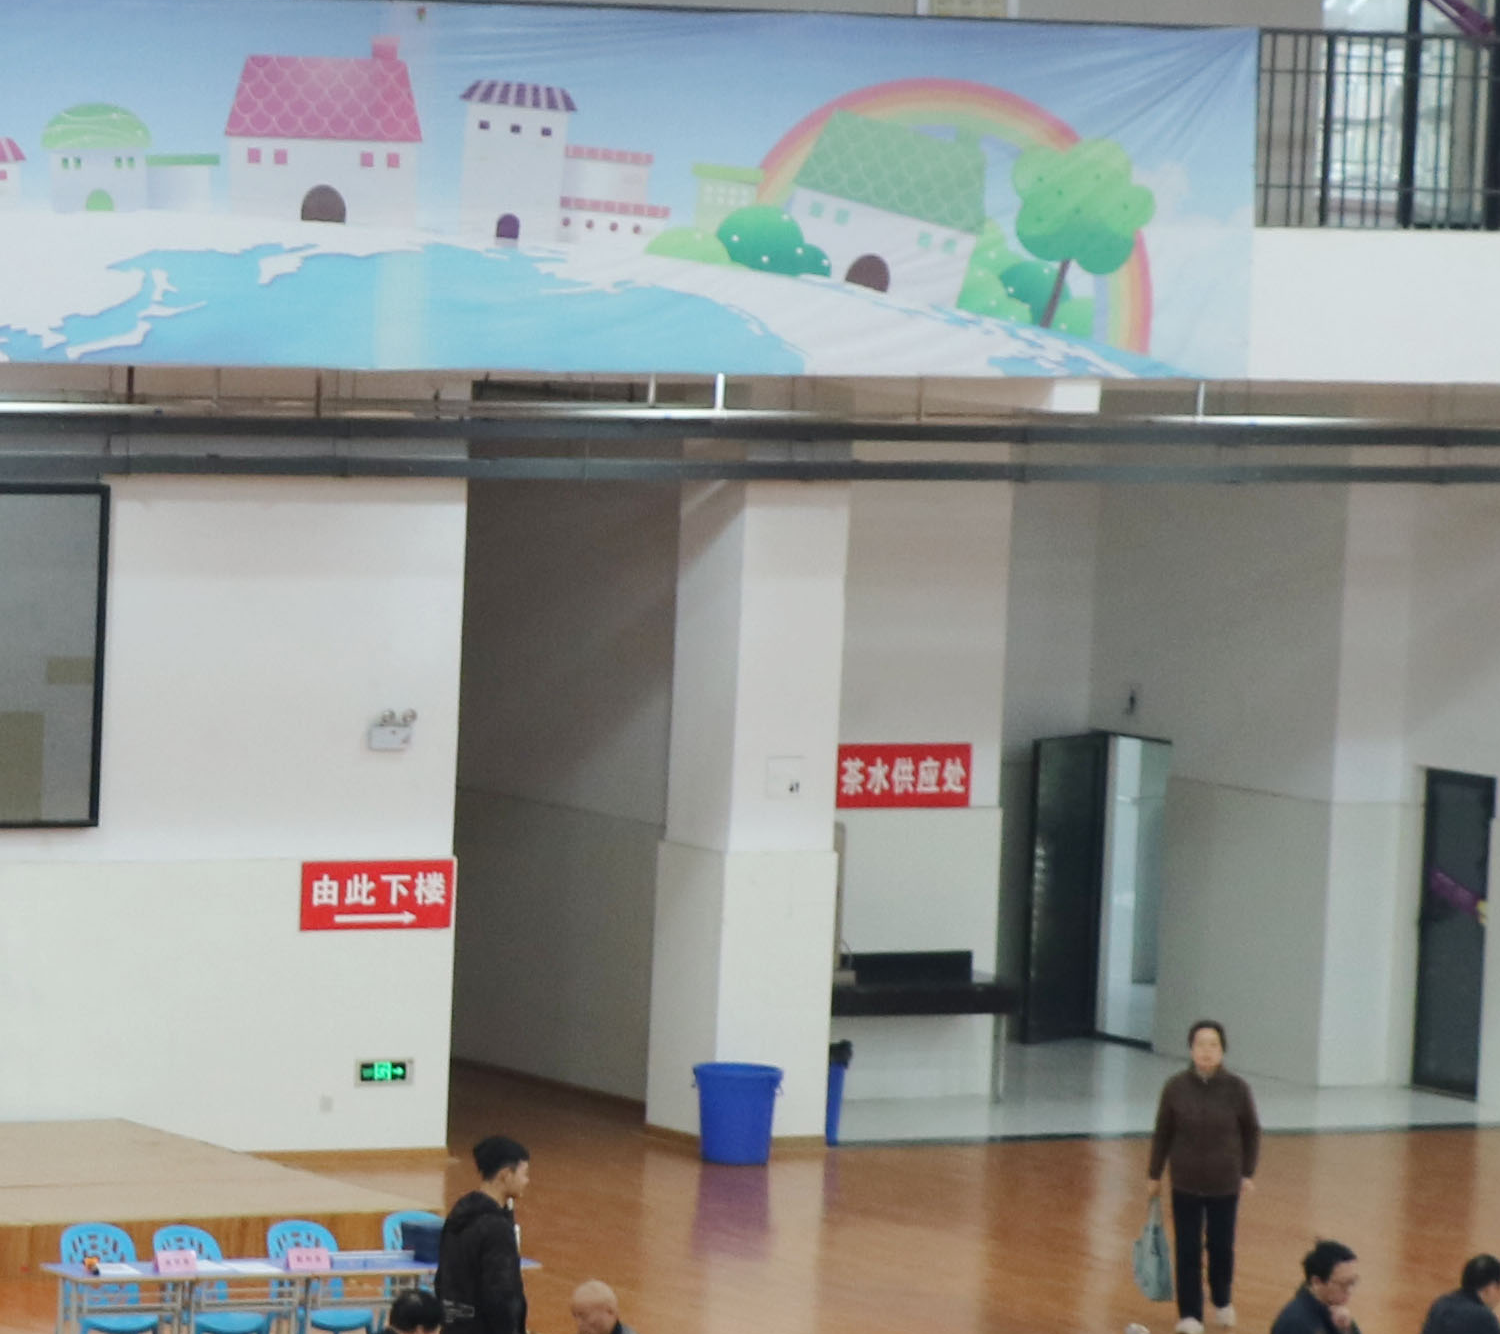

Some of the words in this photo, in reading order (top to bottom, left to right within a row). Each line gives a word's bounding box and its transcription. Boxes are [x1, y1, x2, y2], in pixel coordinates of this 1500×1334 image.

[841, 756, 967, 796] 茶水供应处
[311, 871, 447, 907] 由此下楼
